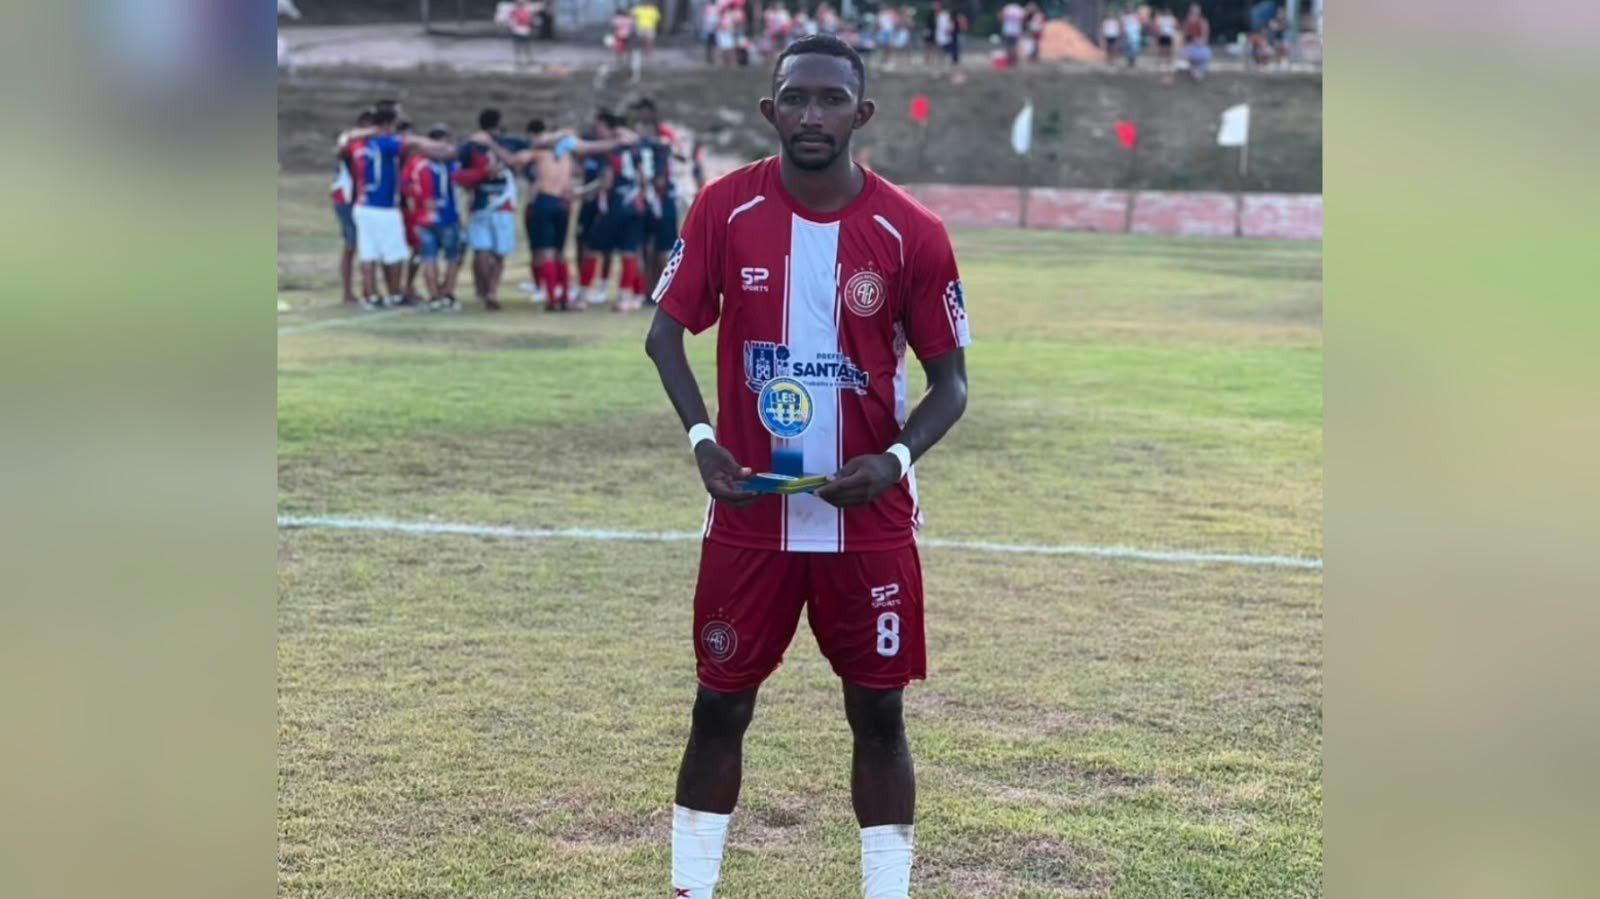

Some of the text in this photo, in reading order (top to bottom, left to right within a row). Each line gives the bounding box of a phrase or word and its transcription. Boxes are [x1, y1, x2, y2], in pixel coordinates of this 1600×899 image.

[740, 267, 769, 285] SP
[871, 583, 899, 602] SP
[876, 611, 900, 657] 8
